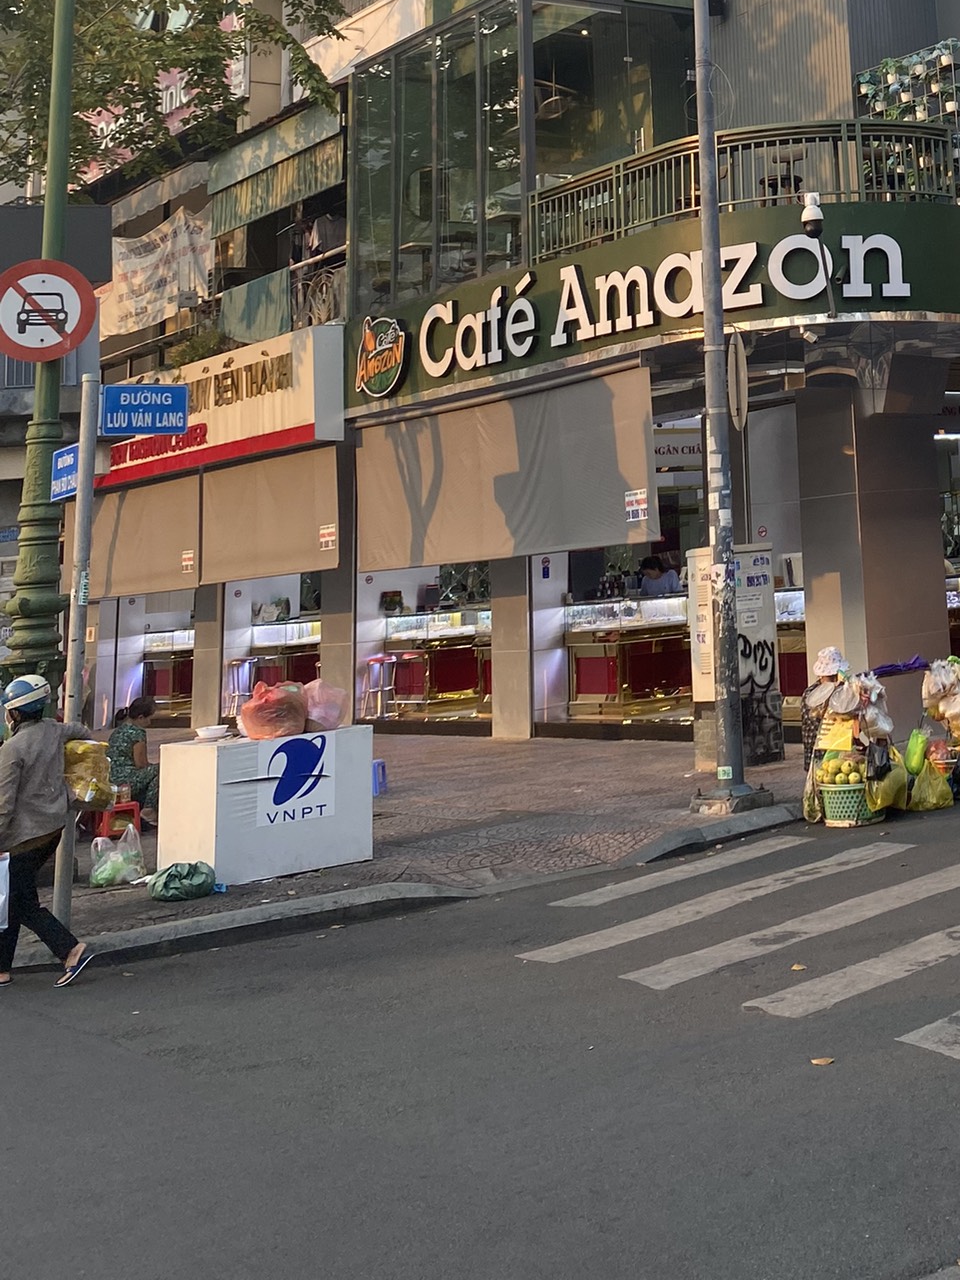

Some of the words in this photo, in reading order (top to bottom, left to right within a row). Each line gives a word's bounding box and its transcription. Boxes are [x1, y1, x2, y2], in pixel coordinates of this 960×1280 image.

[419, 271, 536, 378] Café
[550, 233, 911, 347] Amazon
[120, 390, 172, 405] ĐƯỜNG
[107, 410, 128, 428] LƯU
[131, 408, 152, 428] VĂN
[155, 412, 184, 428] LANG
[681, 443, 702, 455] CHÂ
[266, 804, 327, 824] VNPT
